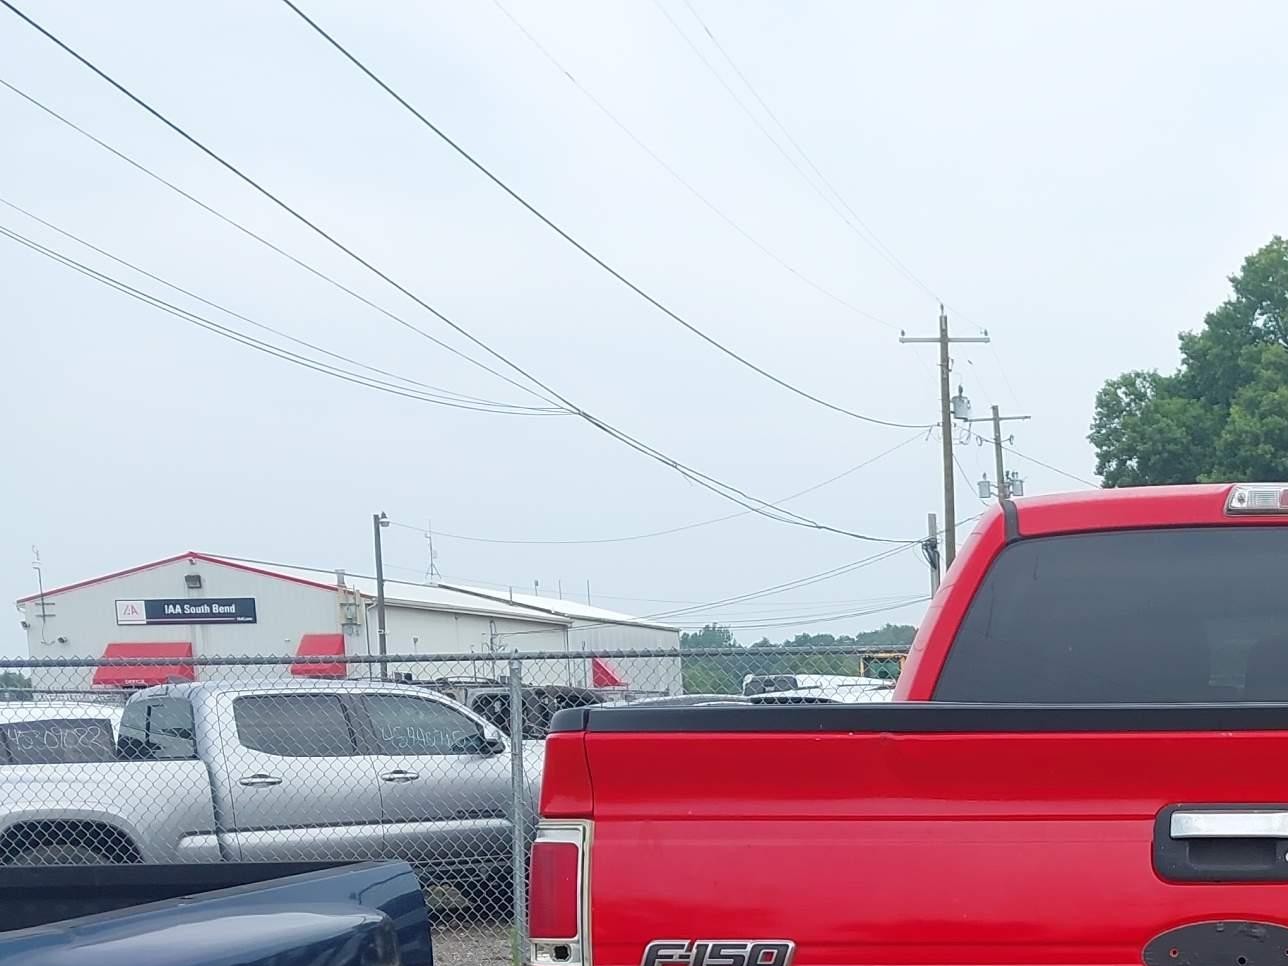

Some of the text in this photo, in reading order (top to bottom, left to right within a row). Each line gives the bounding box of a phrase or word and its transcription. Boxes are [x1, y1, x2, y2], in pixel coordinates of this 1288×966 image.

[164, 603, 236, 614] IAA South Bend
